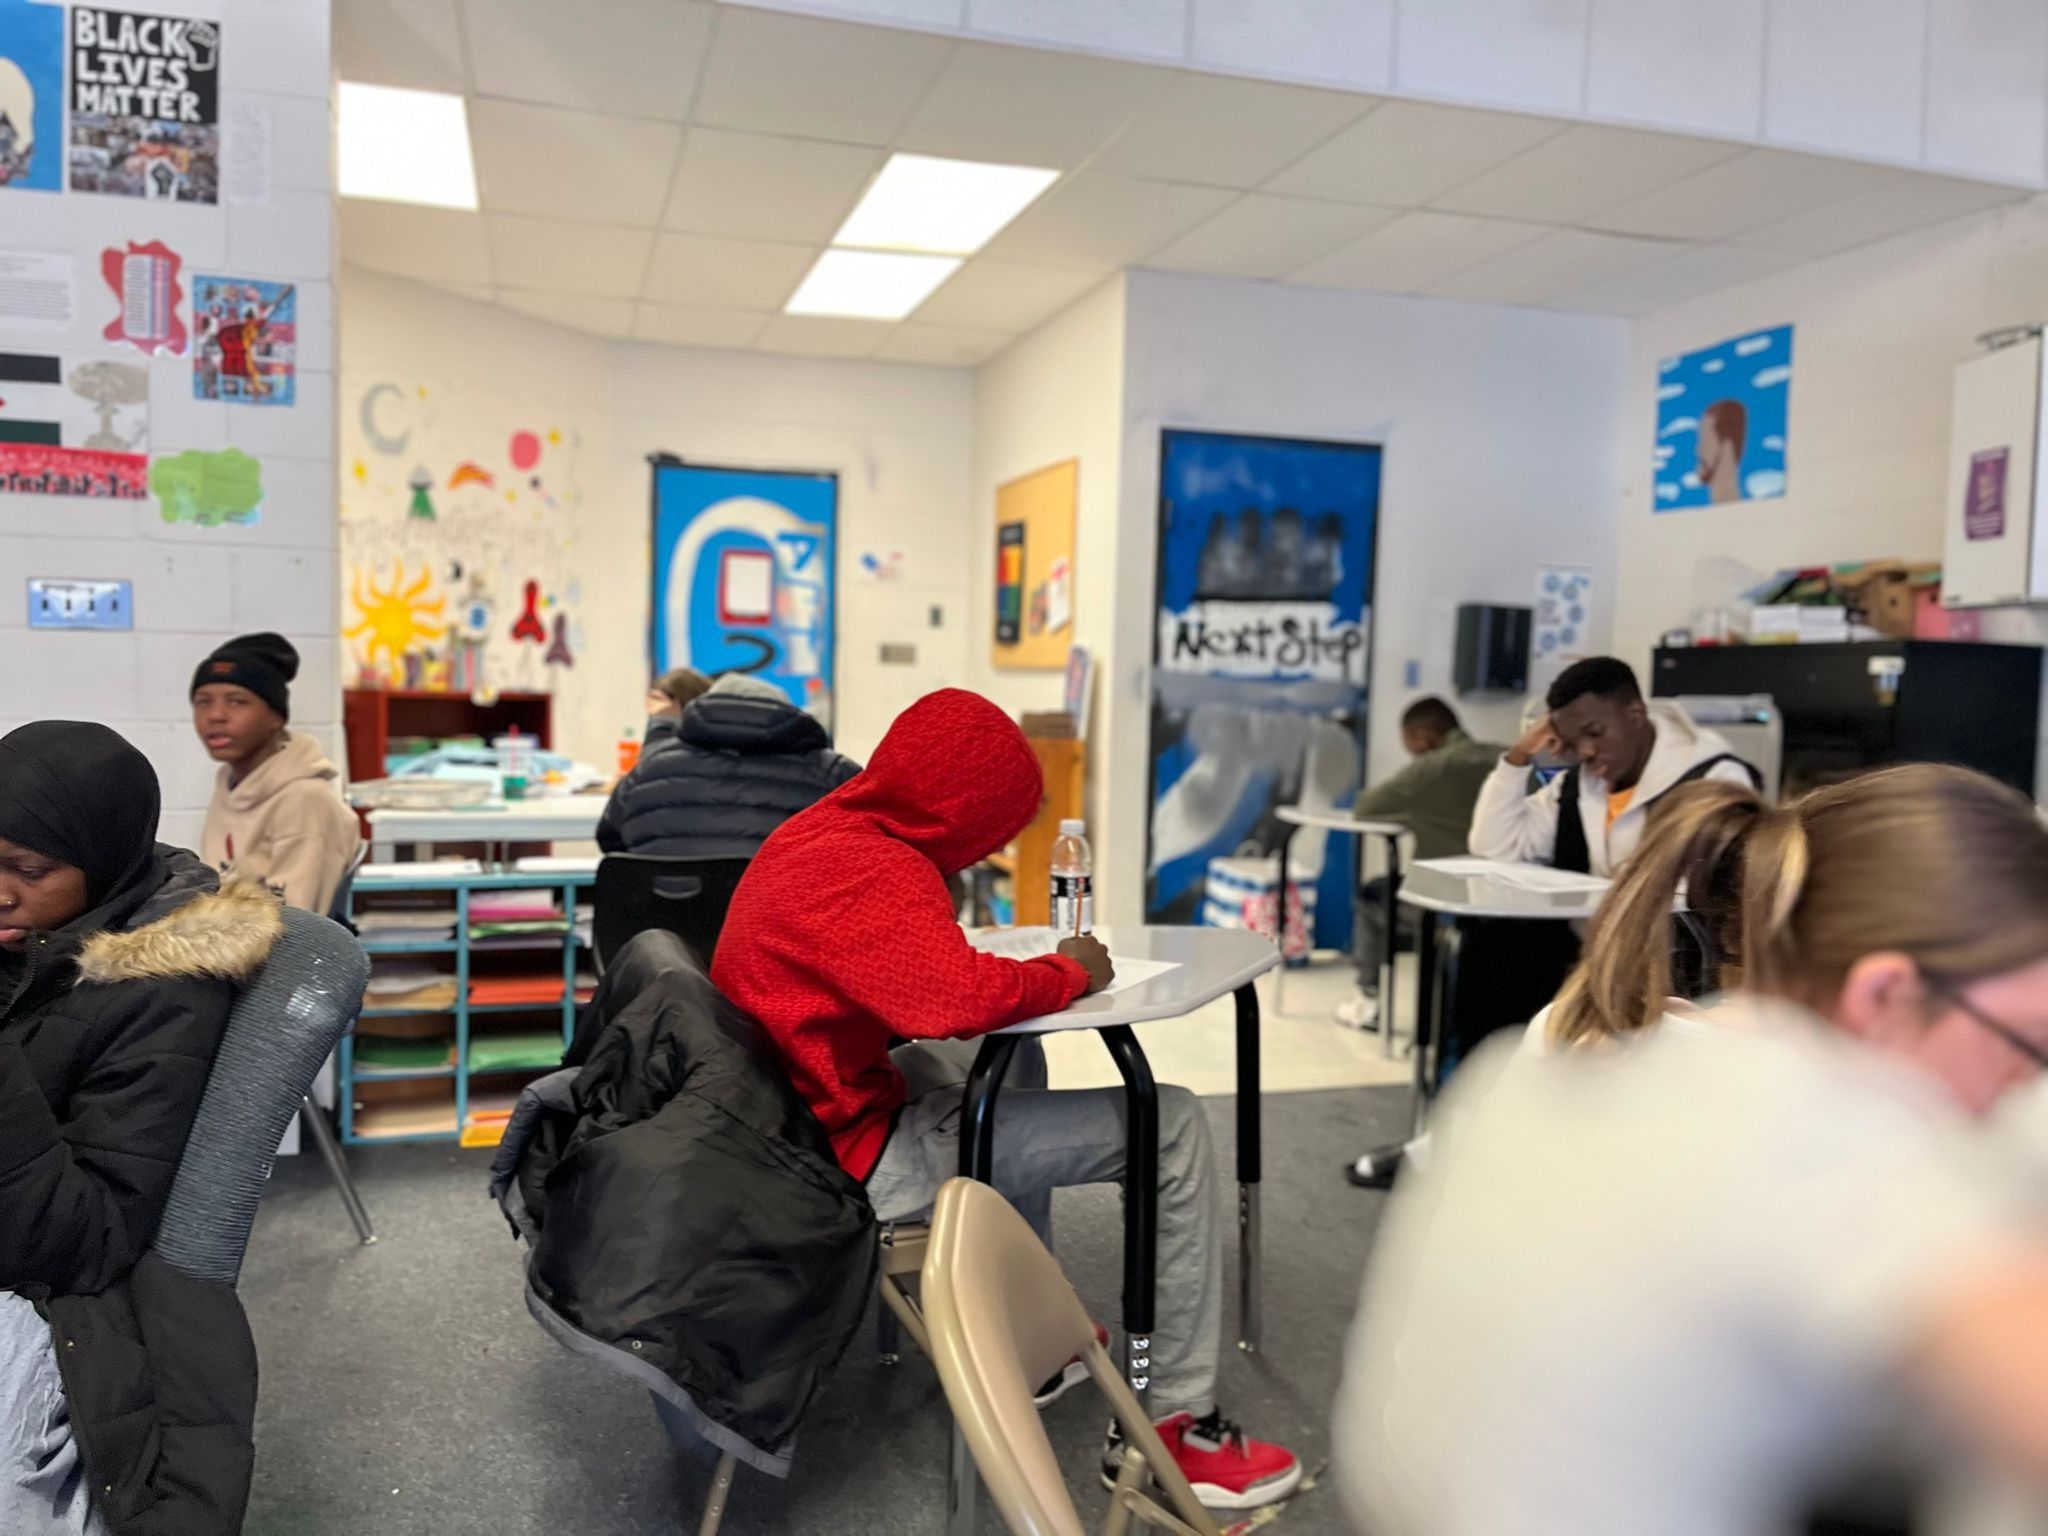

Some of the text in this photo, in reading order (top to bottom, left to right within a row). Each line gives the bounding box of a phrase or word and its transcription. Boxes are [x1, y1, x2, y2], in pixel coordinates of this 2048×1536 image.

[75, 8, 187, 57] BLACK
[76, 49, 189, 92] LIVES
[76, 82, 202, 122] MATTER
[1174, 616, 1362, 684] Next Step
